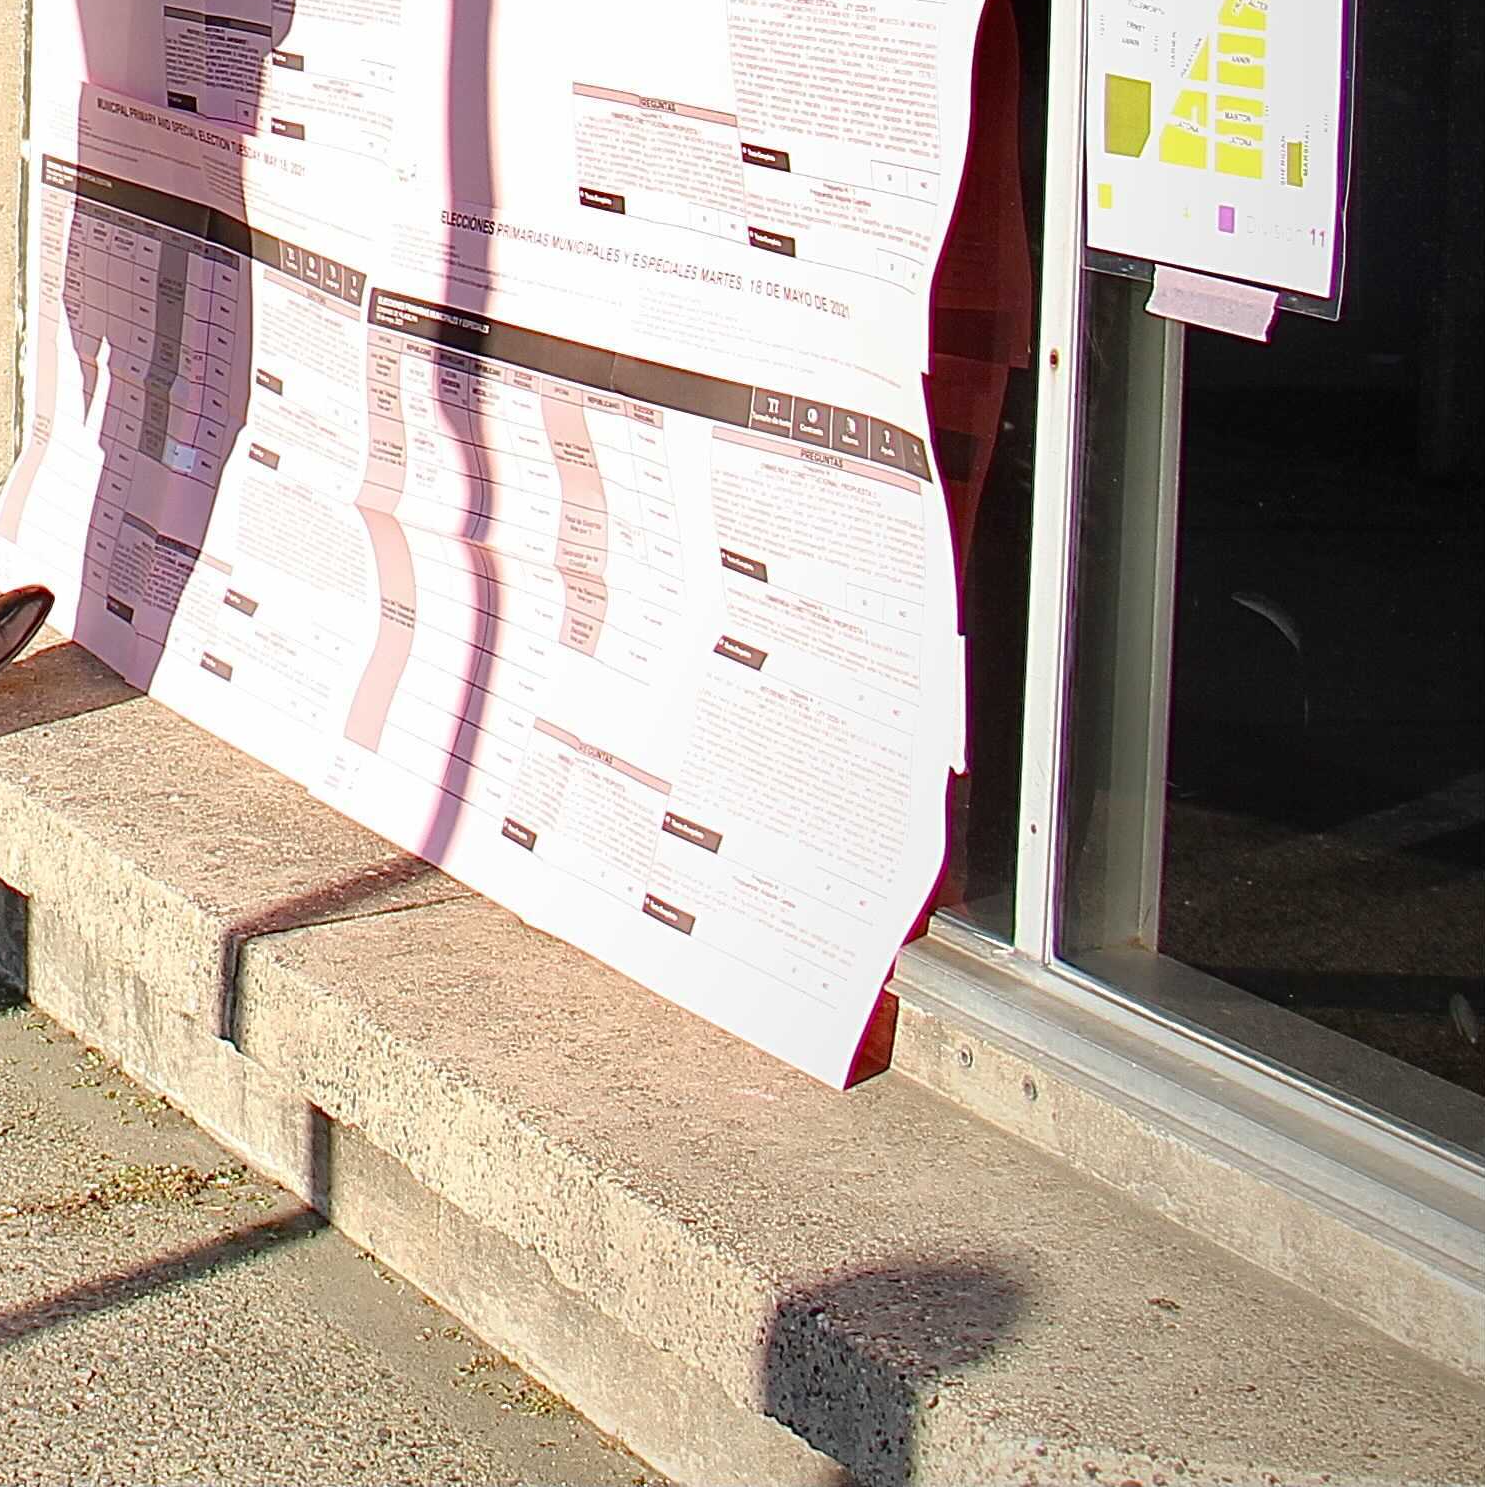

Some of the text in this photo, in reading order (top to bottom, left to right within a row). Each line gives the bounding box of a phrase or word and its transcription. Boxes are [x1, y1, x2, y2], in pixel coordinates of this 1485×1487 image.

[129, 106, 156, 127] PRIMARY
[157, 116, 171, 131] AND
[172, 120, 199, 141] SPECIAL
[199, 128, 231, 152] ELECTION
[290, 161, 306, 177] 2021
[496, 223, 550, 248] PRIMARIAS
[551, 234, 620, 263] MUNICIPALES
[623, 253, 630, 265] Y
[632, 253, 698, 281] ESPECIALES
[700, 267, 745, 293] MARTES,
[749, 279, 762, 295] 18
[765, 282, 781, 300] DE
[783, 286, 813, 308] MAYO
[814, 295, 829, 313] DE
[829, 299, 851, 320] 2021
[1309, 228, 1326, 247] 11
